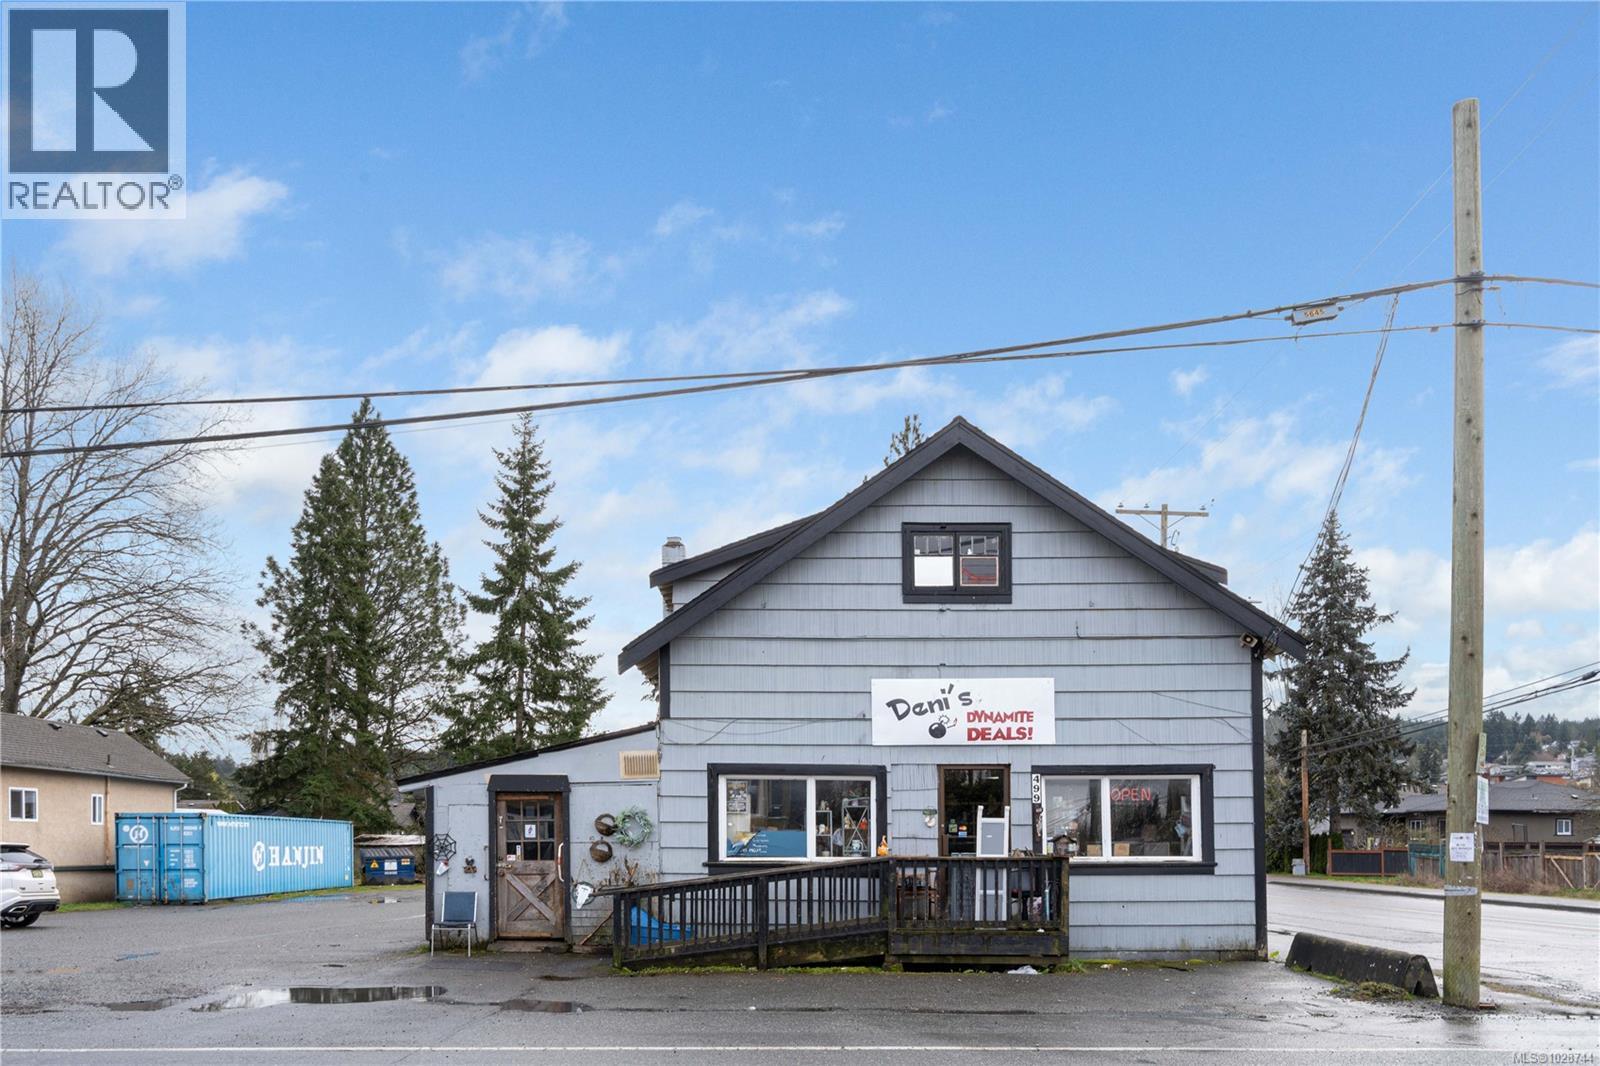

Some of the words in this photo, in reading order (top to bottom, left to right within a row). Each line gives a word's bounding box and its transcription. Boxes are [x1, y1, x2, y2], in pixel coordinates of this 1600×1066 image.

[886, 683, 973, 721] Deni's
[966, 710, 1034, 723] DYNAMITE
[966, 726, 1034, 742] DEALS!
[1032, 774, 1041, 803] 499
[1110, 785, 1152, 802] OPEN
[268, 845, 324, 869] HANJIN
